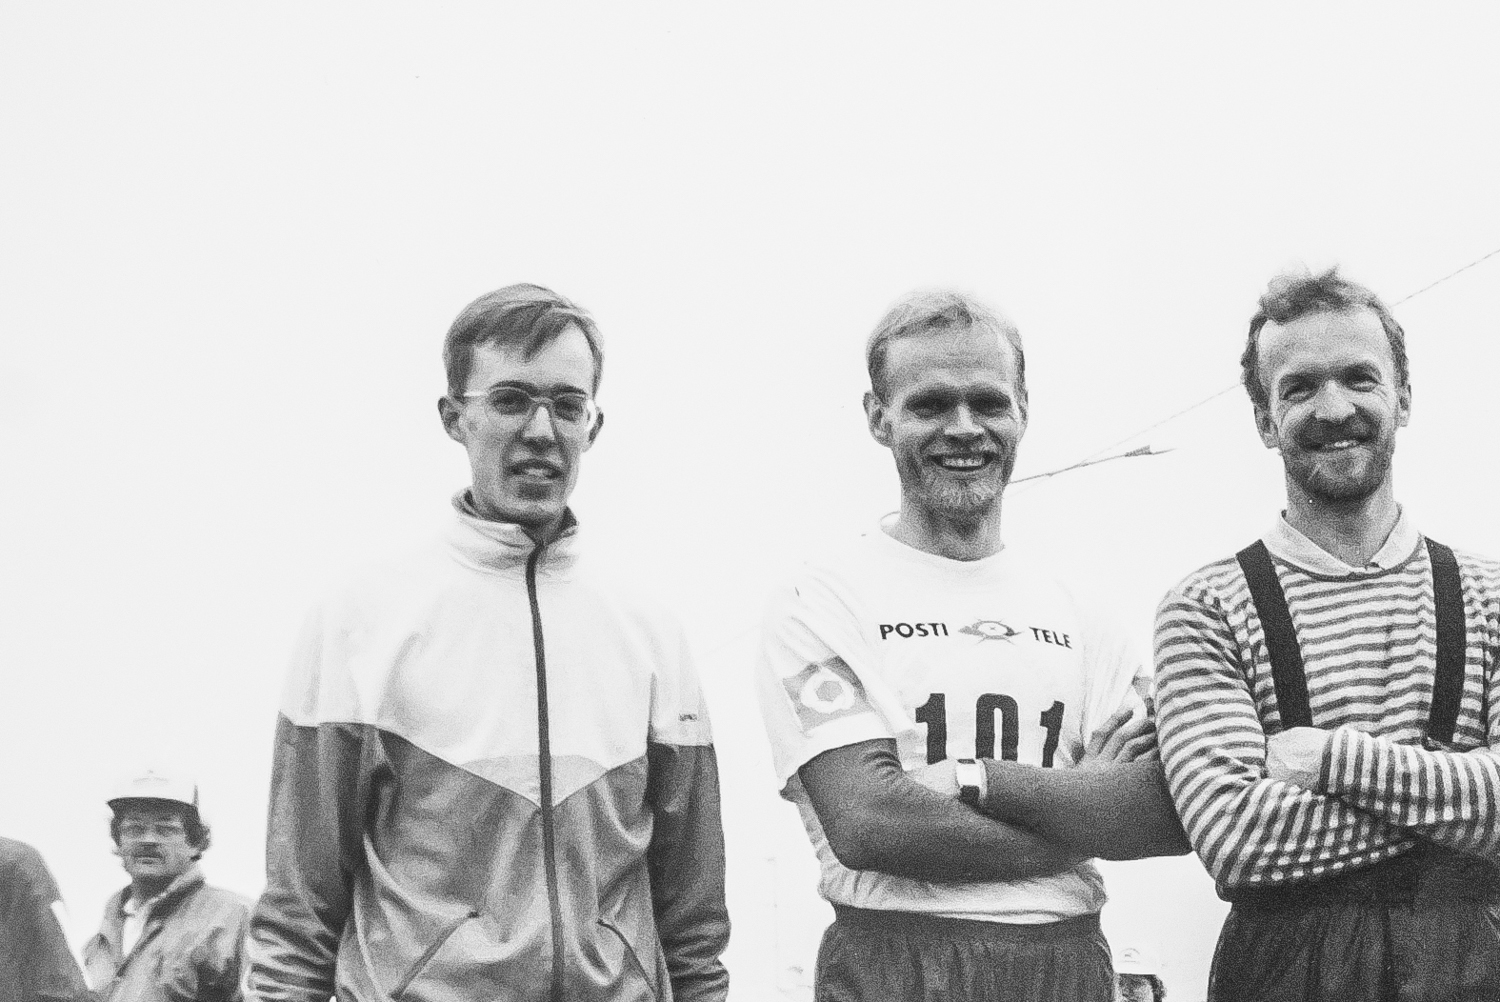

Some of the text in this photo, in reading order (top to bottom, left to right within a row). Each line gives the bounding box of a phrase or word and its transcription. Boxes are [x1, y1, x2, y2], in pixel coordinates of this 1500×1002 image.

[879, 622, 1073, 650] POSTI TELE
[915, 693, 1065, 768] 101
